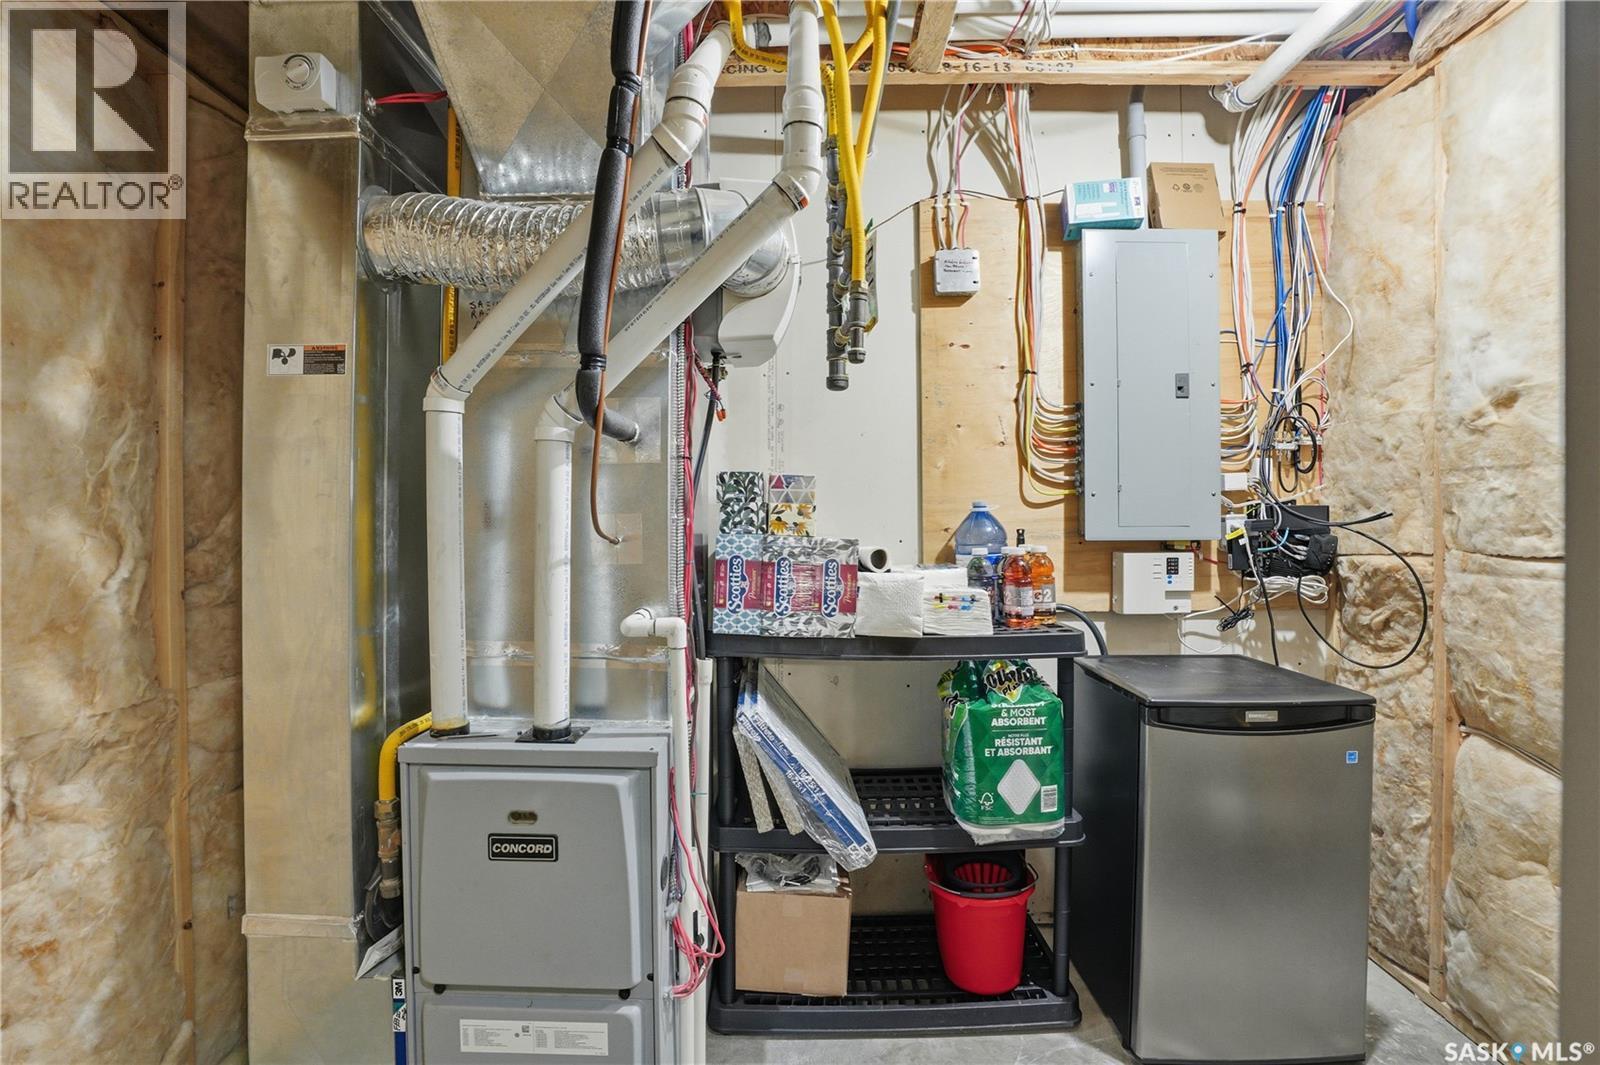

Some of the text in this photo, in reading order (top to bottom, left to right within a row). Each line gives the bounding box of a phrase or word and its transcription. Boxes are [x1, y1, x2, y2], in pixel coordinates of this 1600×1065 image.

[727, 556, 743, 613] Scotties
[775, 559, 790, 616] Scotties
[823, 561, 838, 618] Scotties
[1001, 708, 1037, 717] & MOST
[991, 716, 1048, 727] ABSORBENT
[994, 736, 1043, 747] RÉSISTANT
[984, 746, 1053, 757] ET ABSORBANT
[492, 843, 553, 854] CONCORD
[394, 982, 403, 996] 3M
